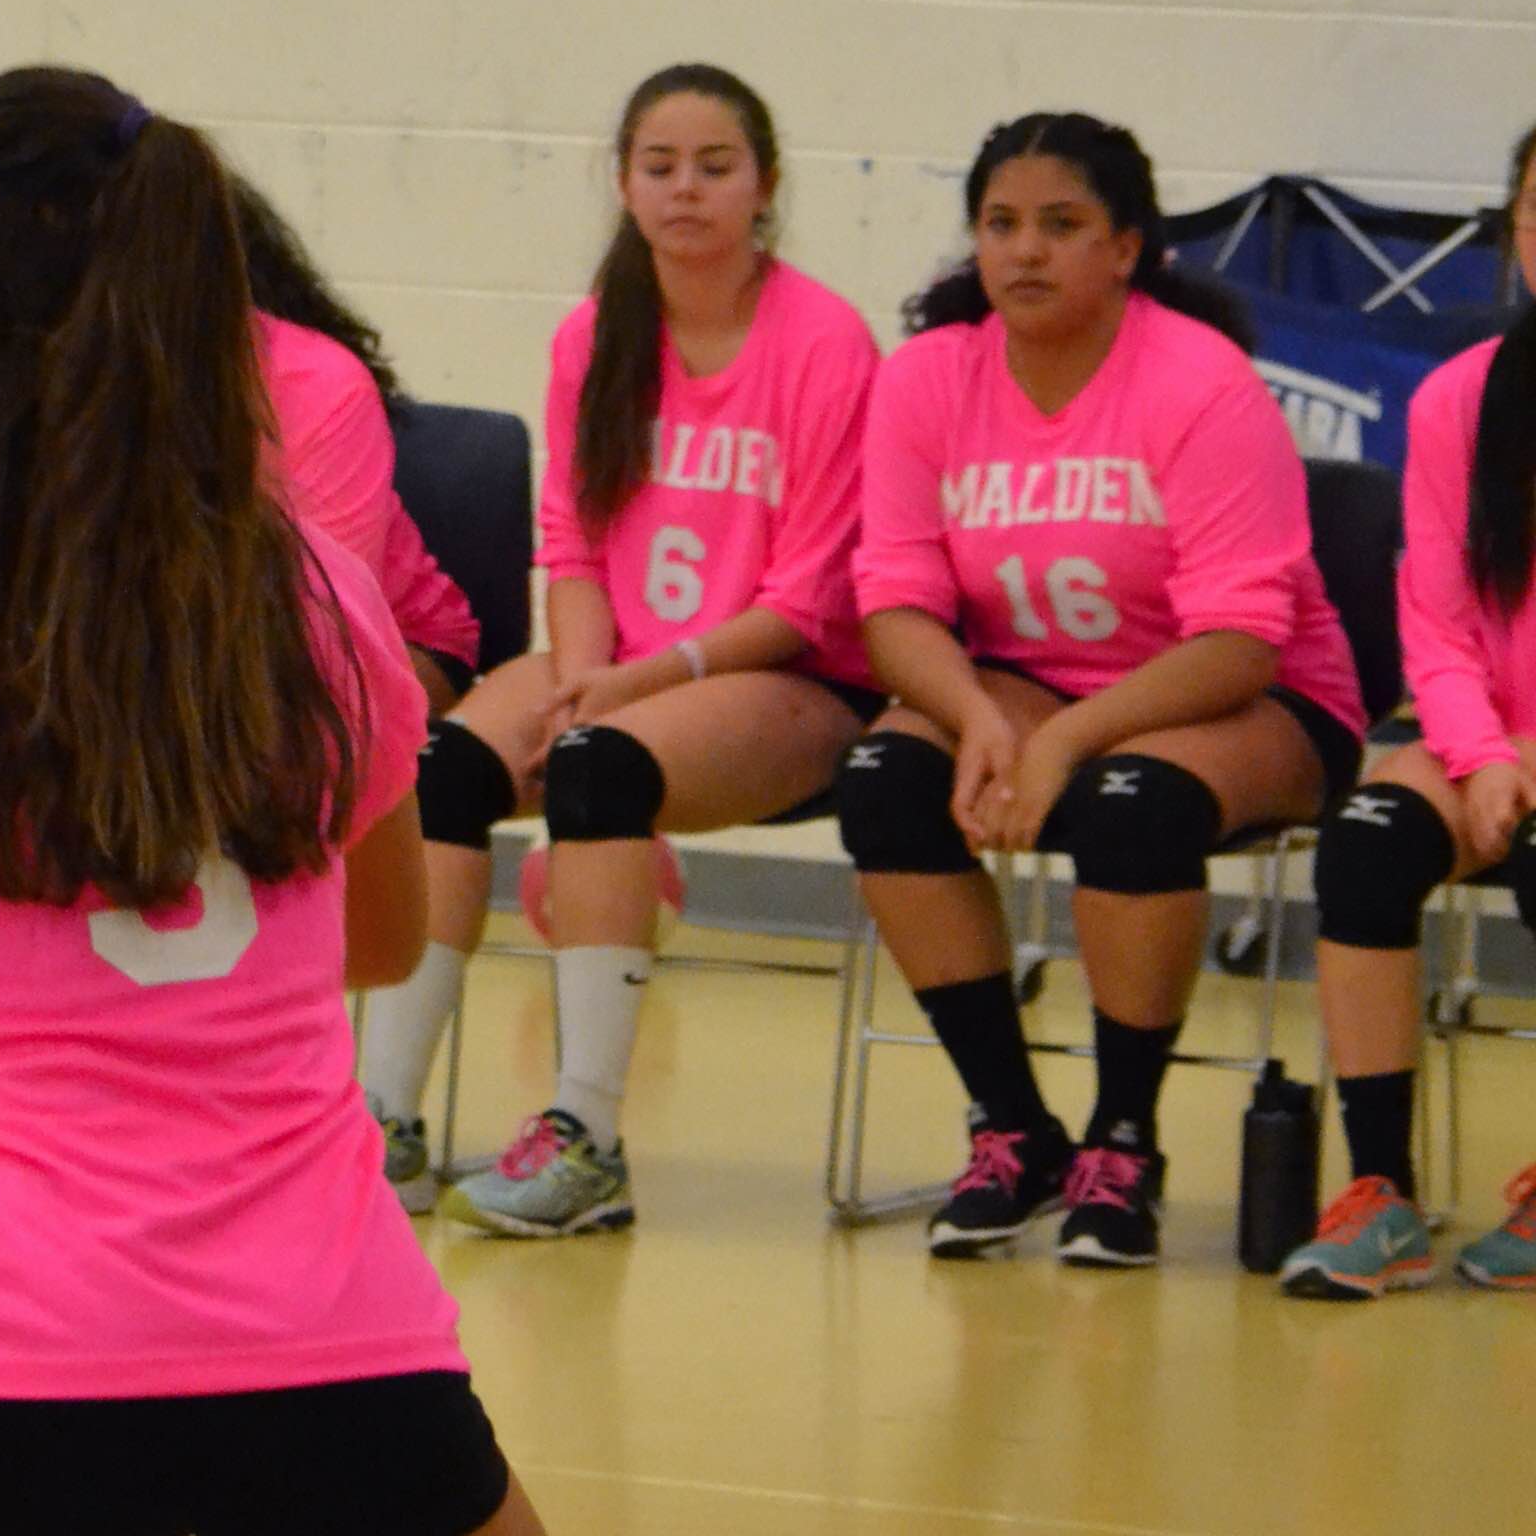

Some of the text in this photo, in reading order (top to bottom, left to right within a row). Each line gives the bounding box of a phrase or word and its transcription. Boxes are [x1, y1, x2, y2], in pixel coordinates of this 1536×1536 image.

[940, 455, 1168, 530] MALDEN
[644, 524, 708, 624] 6
[993, 553, 1123, 643] 16
